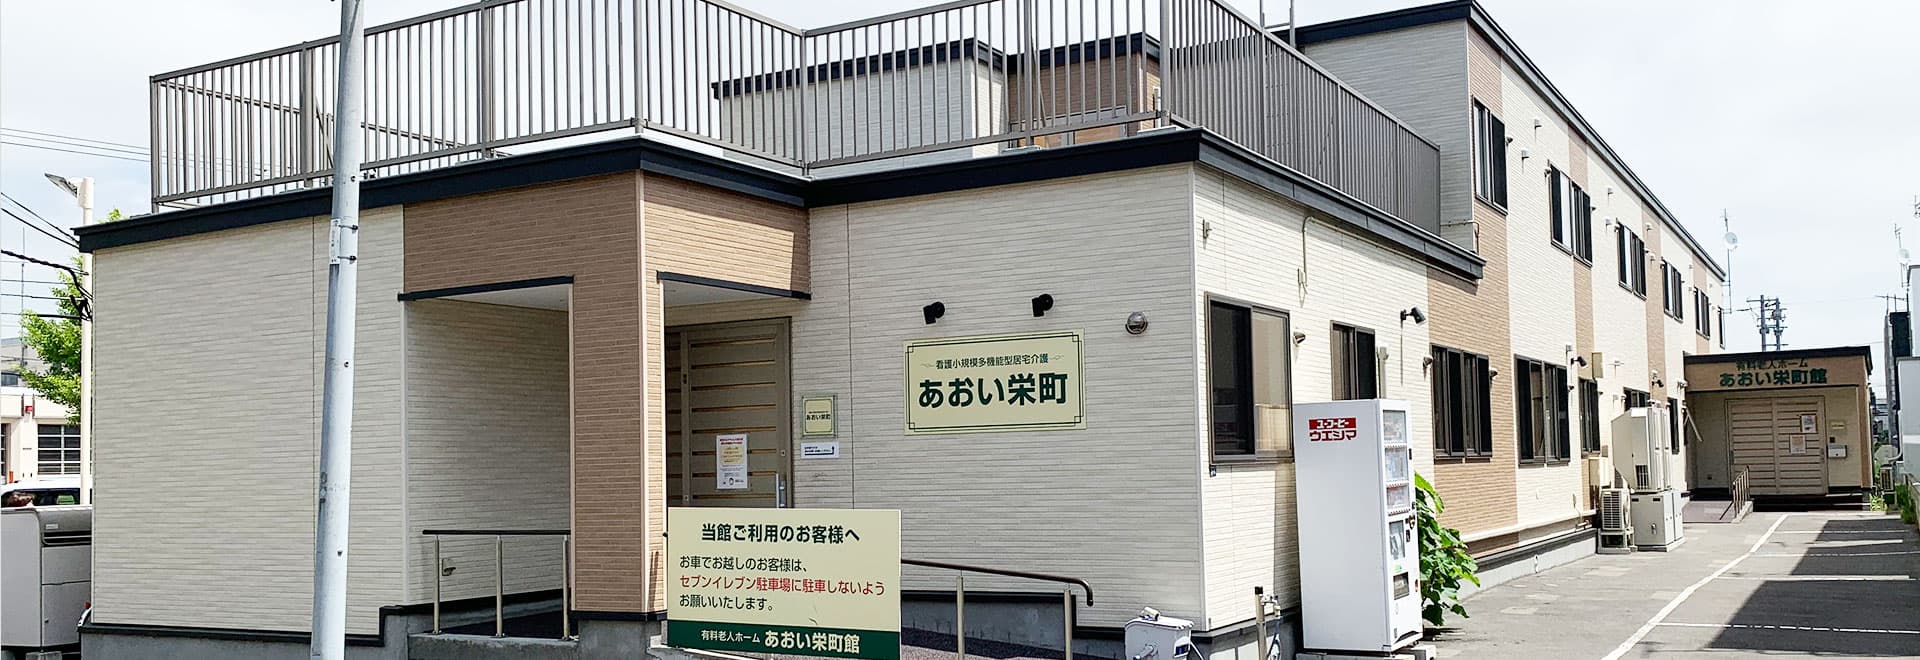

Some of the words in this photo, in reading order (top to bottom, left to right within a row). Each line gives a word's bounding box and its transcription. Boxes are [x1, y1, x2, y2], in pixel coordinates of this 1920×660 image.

[935, 353, 1049, 370] 看護小規模多機能型居宅介護
[1719, 368, 1827, 387] あおい栄町館
[919, 372, 1068, 408] あおい栄町
[1309, 430, 1357, 441] ウエシマ
[701, 523, 860, 544] 当館ご利用のお客様へ
[679, 556, 807, 573] お車でお越しのお客様は、
[679, 576, 885, 596] セブンイレブン駐車場に駐車しないよう
[679, 594, 774, 612] お願いいたします。
[701, 629, 760, 643] 有料老人ホーム
[764, 630, 860, 654] あおい栄町館
